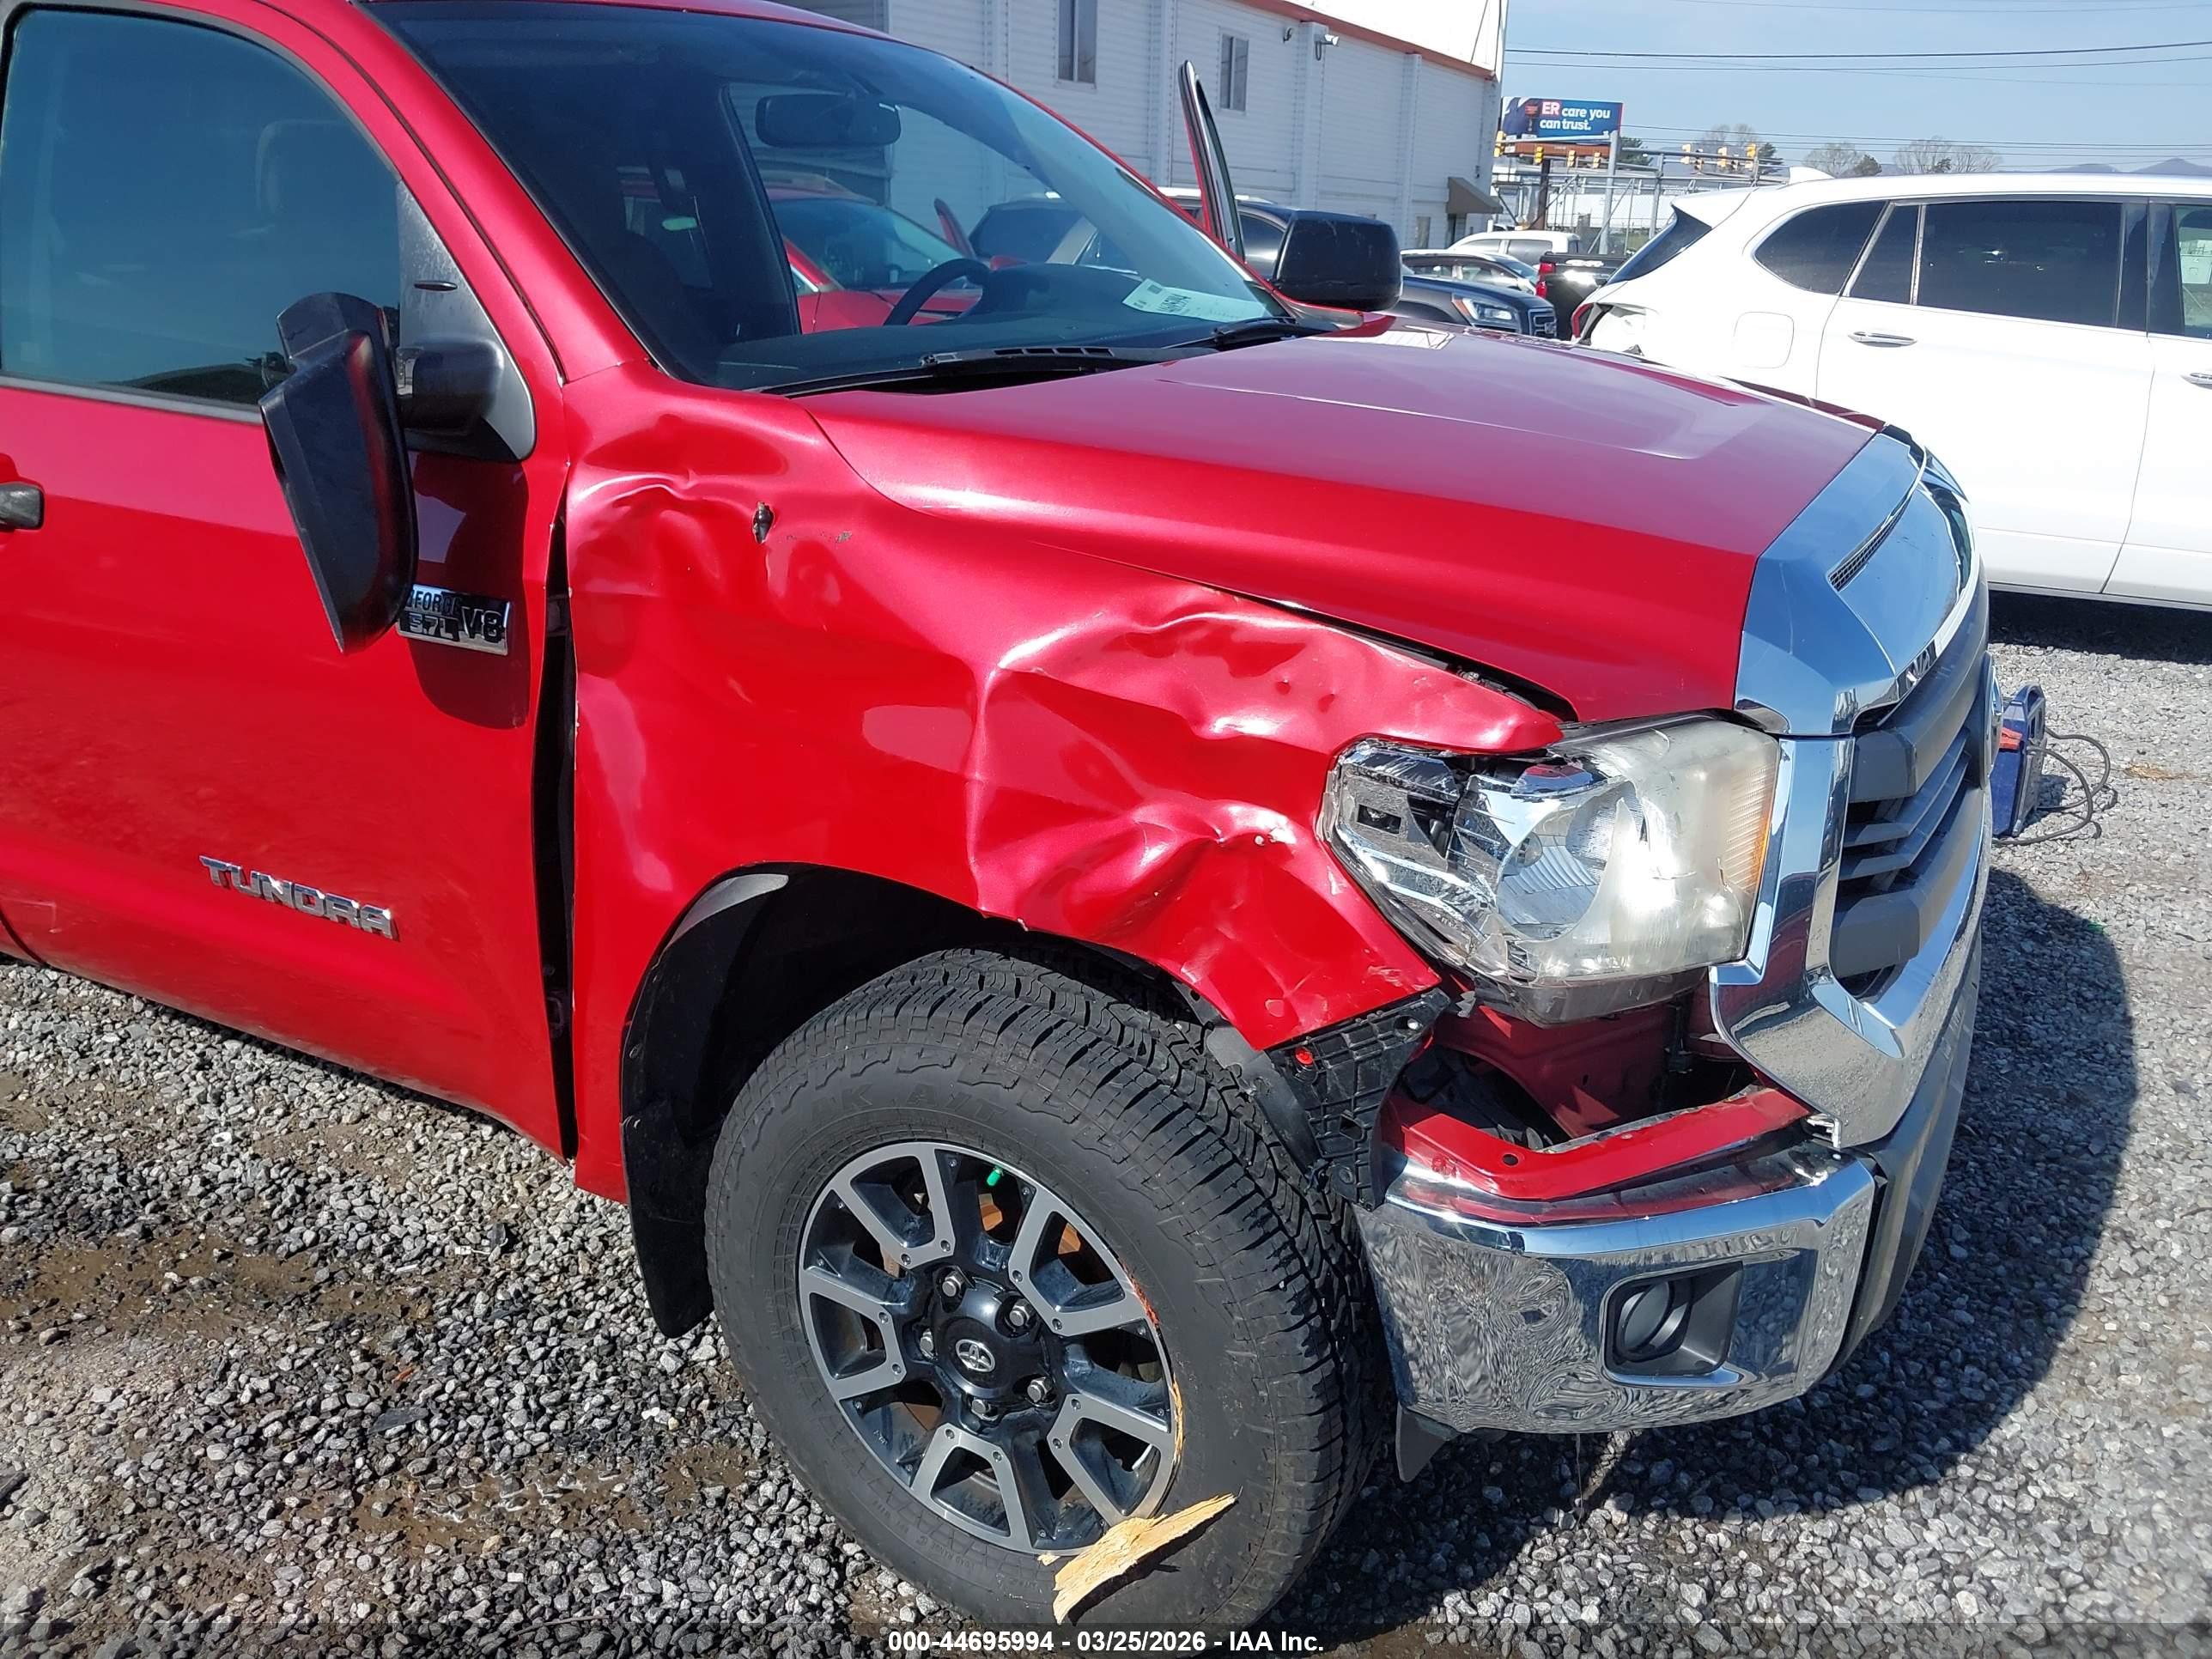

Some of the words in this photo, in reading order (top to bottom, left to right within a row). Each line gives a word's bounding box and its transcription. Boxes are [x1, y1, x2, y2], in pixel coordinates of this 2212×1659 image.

[1539, 118, 1561, 130] can
[1562, 118, 1592, 131] trust.
[1541, 101, 1560, 115] ER
[1561, 107, 1588, 118] care
[1589, 108, 1611, 121] you
[461, 606, 502, 643] V8
[198, 855, 394, 939] TUNDRA
